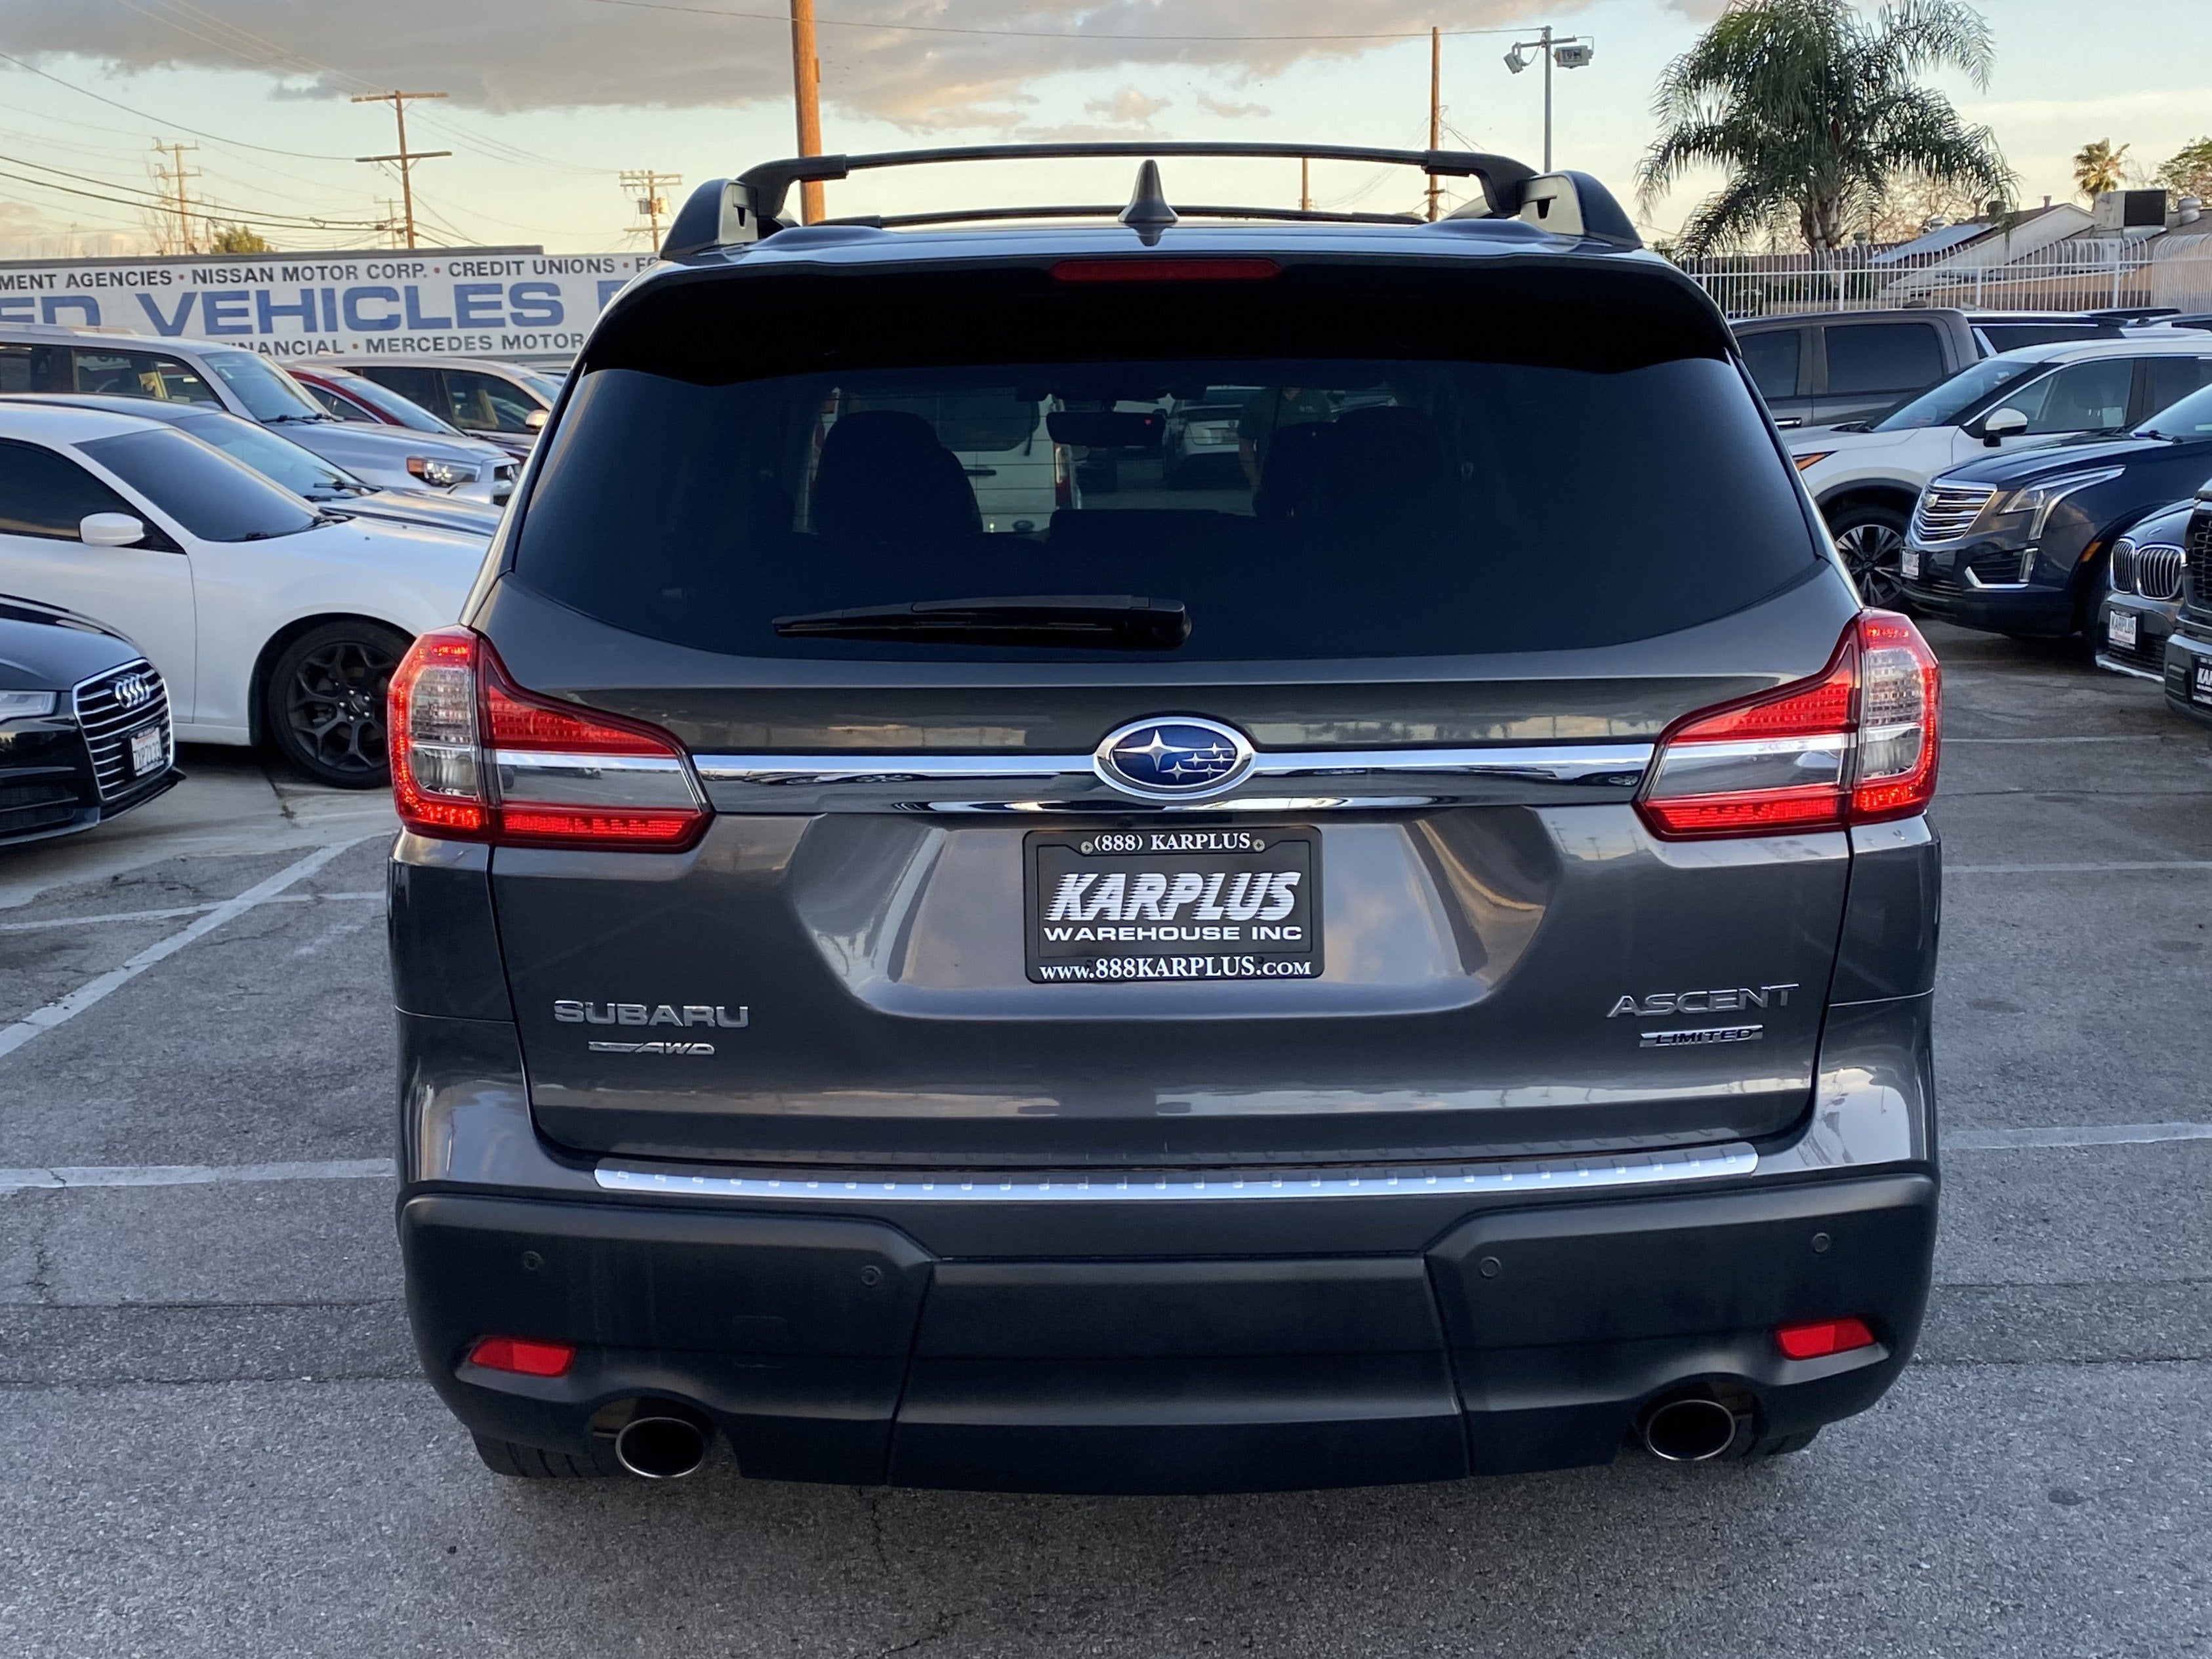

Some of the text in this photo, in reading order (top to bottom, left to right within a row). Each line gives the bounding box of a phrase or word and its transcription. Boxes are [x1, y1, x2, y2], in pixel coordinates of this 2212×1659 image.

[66, 270, 172, 289] AGENCIES
[192, 266, 274, 284] NISSAN
[282, 264, 358, 282] MOTOR
[367, 262, 428, 280] CORP.
[449, 260, 525, 277] CREDIT
[533, 258, 615, 276] UNIONS
[135, 281, 564, 337] VEHICLES
[366, 335, 492, 354] MERCEDES
[1094, 832, 1252, 852] (888) KARPLUS
[1044, 870, 1301, 921] KARPLUS
[1044, 926, 1302, 941] WAREHOUSE INC
[1607, 983, 1799, 1017] ASCENT
[554, 1000, 748, 1028] SUBARU
[634, 1042, 715, 1055] AWD
[1655, 1029, 1753, 1044] LIMITED
